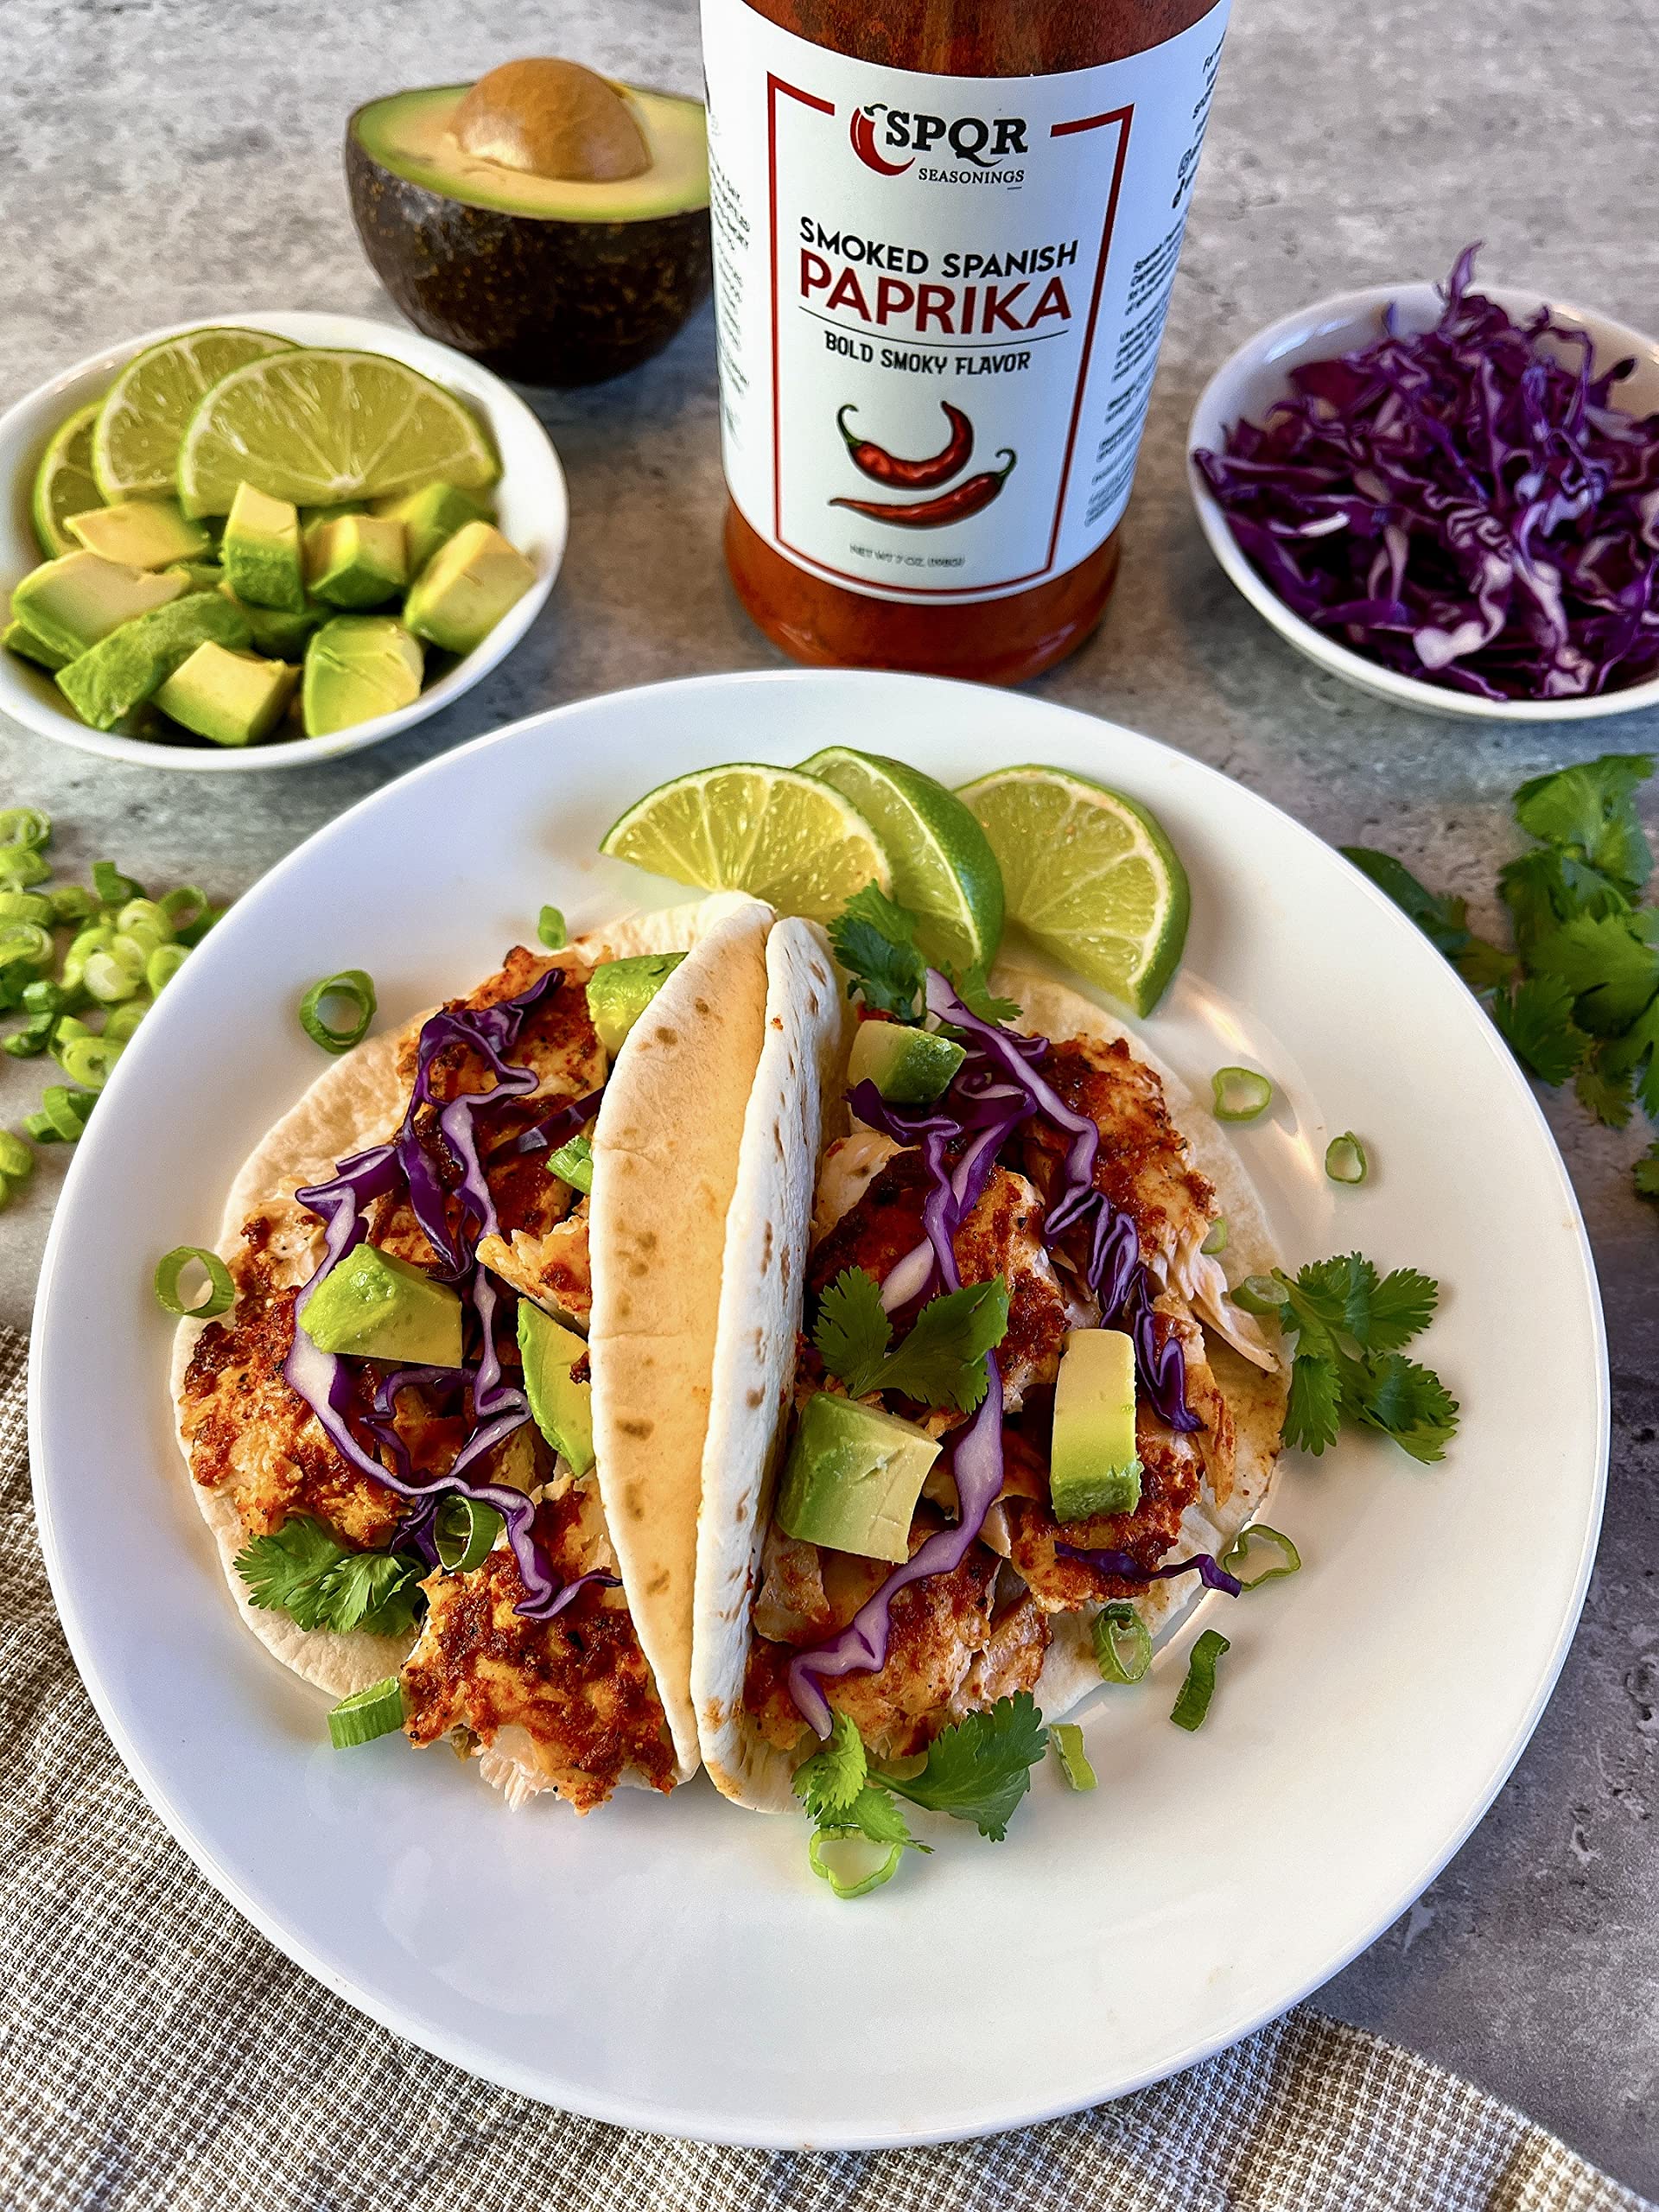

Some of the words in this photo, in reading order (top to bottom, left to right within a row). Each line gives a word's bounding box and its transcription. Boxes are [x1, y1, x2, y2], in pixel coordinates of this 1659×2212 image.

[886, 110, 1028, 168] SPQR
[918, 168, 1025, 184] SEASONINGS
[799, 216, 929, 275] SMOKED
[941, 239, 1078, 278] SPANISH
[800, 247, 1072, 334] PAPRIKA
[824, 330, 874, 364] BOLD
[880, 349, 948, 374] SMOKY
[956, 352, 1031, 375] FLAVOR
